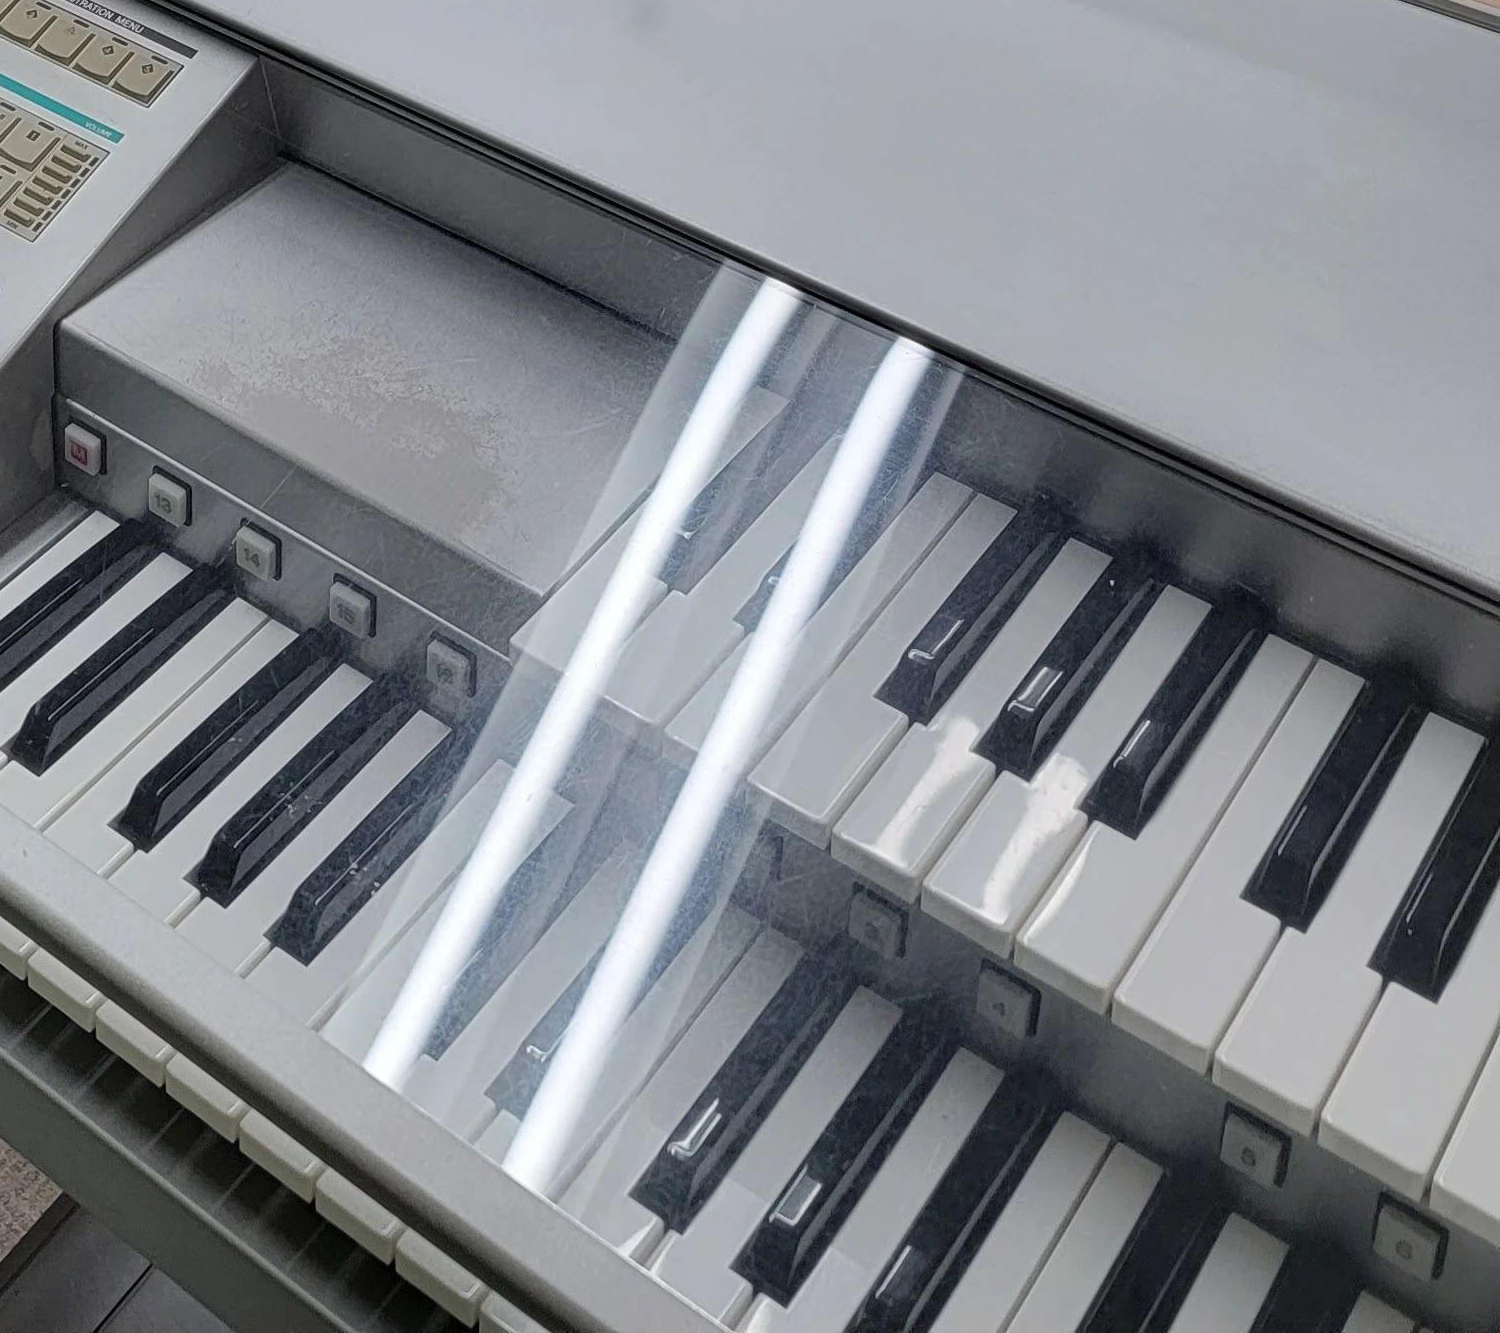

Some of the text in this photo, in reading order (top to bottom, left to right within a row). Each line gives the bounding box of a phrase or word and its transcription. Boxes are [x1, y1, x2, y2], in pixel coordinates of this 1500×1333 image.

[114, 16, 145, 34] MENU
[74, 140, 89, 150] MAX
[155, 493, 172, 514] 13
[243, 548, 261, 568] 14
